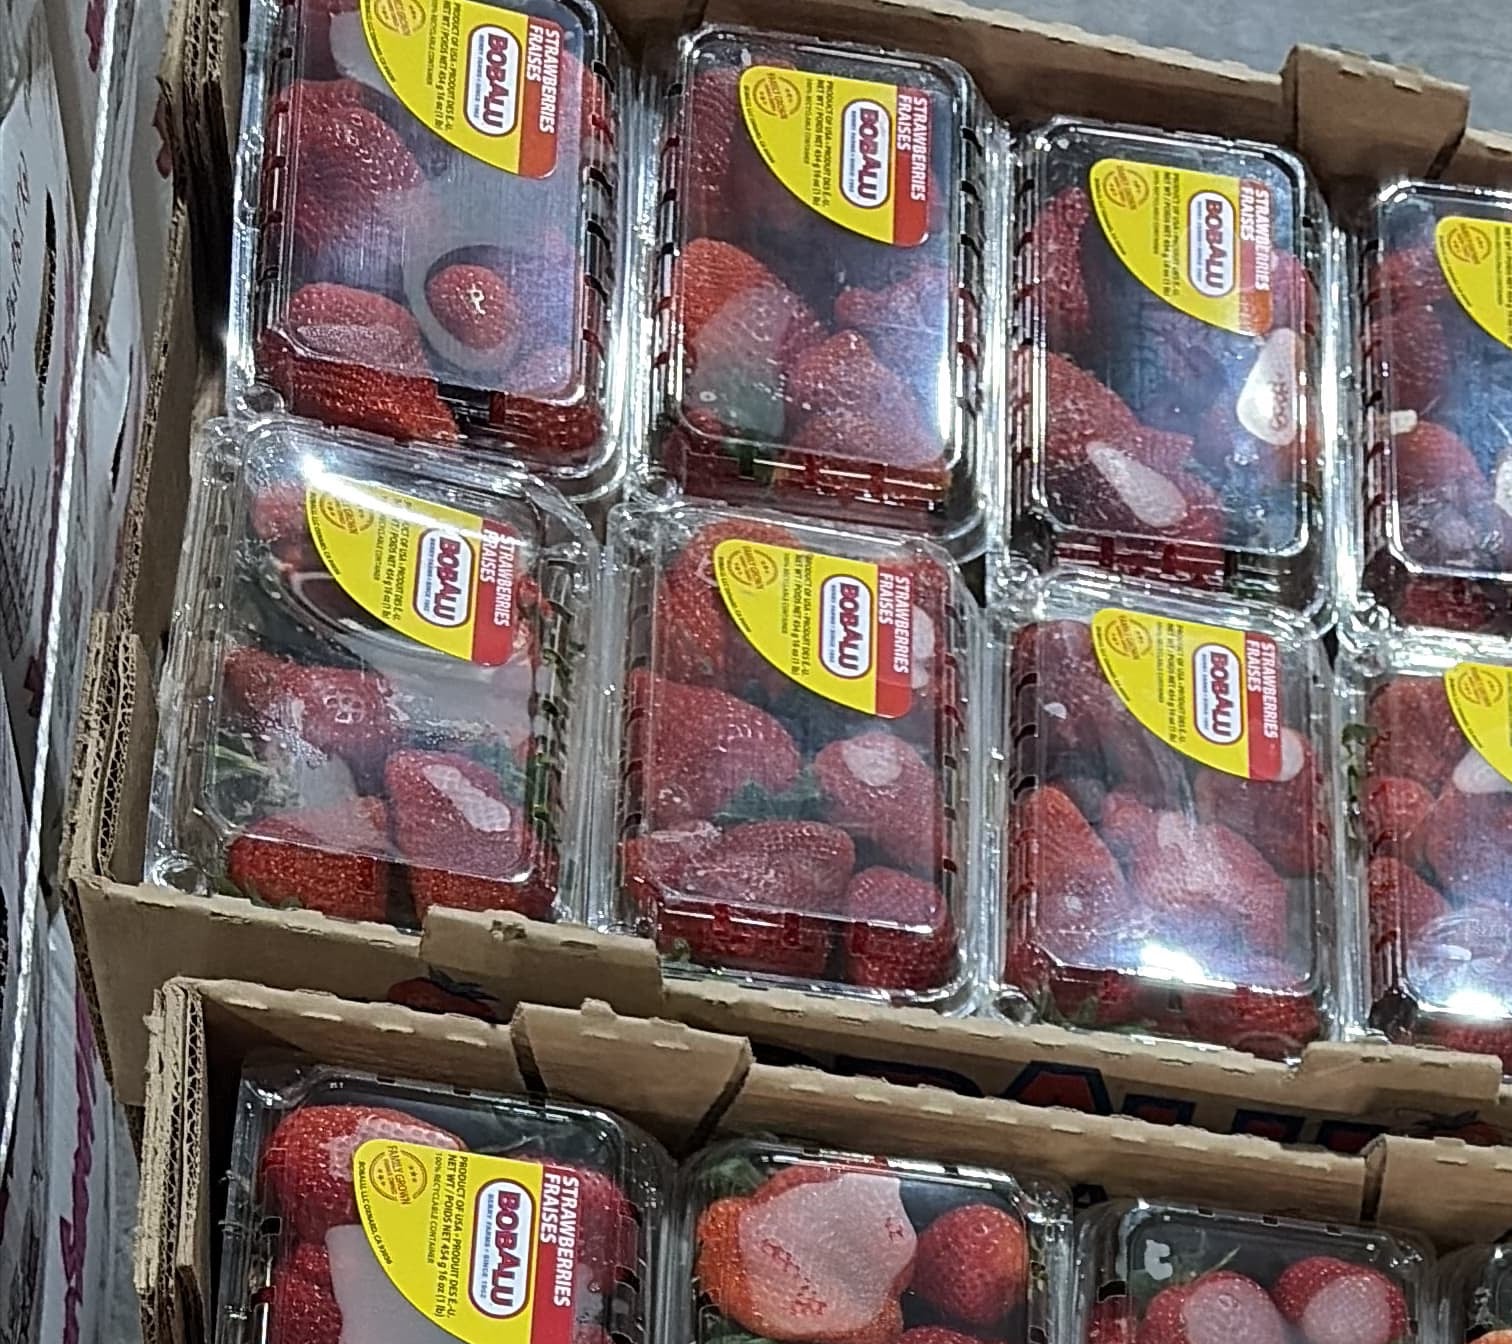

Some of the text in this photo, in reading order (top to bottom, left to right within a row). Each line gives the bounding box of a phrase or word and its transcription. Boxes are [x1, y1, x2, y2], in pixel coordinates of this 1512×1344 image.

[482, 33, 508, 128] BOBALU
[526, 23, 544, 82] FRAISES
[538, 27, 560, 134] STRAWBERRIES
[897, 94, 912, 151] FRAISES
[910, 96, 928, 200] STRAWBERRIES
[857, 107, 880, 199] BOBALU
[1205, 199, 1227, 289] BOBALU
[433, 537, 461, 620] BOBALU
[878, 571, 892, 625] FRAISES
[837, 582, 862, 670] BOBALU
[893, 574, 909, 673] STRAWBERRIES
[1210, 651, 1233, 736] BOBALU
[1246, 639, 1260, 692] FRAISES
[1261, 642, 1276, 738] STRAWBERRIES
[445, 1173, 454, 1188] WT
[446, 1154, 456, 1171] NET
[456, 1156, 467, 1198] PRODUCT
[441, 1223, 450, 1242] NET
[443, 1194, 453, 1222] POIDS
[453, 1213, 463, 1231] USA
[455, 1200, 464, 1212] OF
[540, 1172, 560, 1244] FRAISES
[440, 1243, 449, 1261] 454
[450, 1238, 461, 1277] PRODUIT
[489, 1189, 519, 1307] BOBALU
[553, 1175, 578, 1307] STRAWBERRIES
[437, 1282, 444, 1293] oz
[438, 1270, 446, 1281] 16
[448, 1279, 457, 1297] DES
